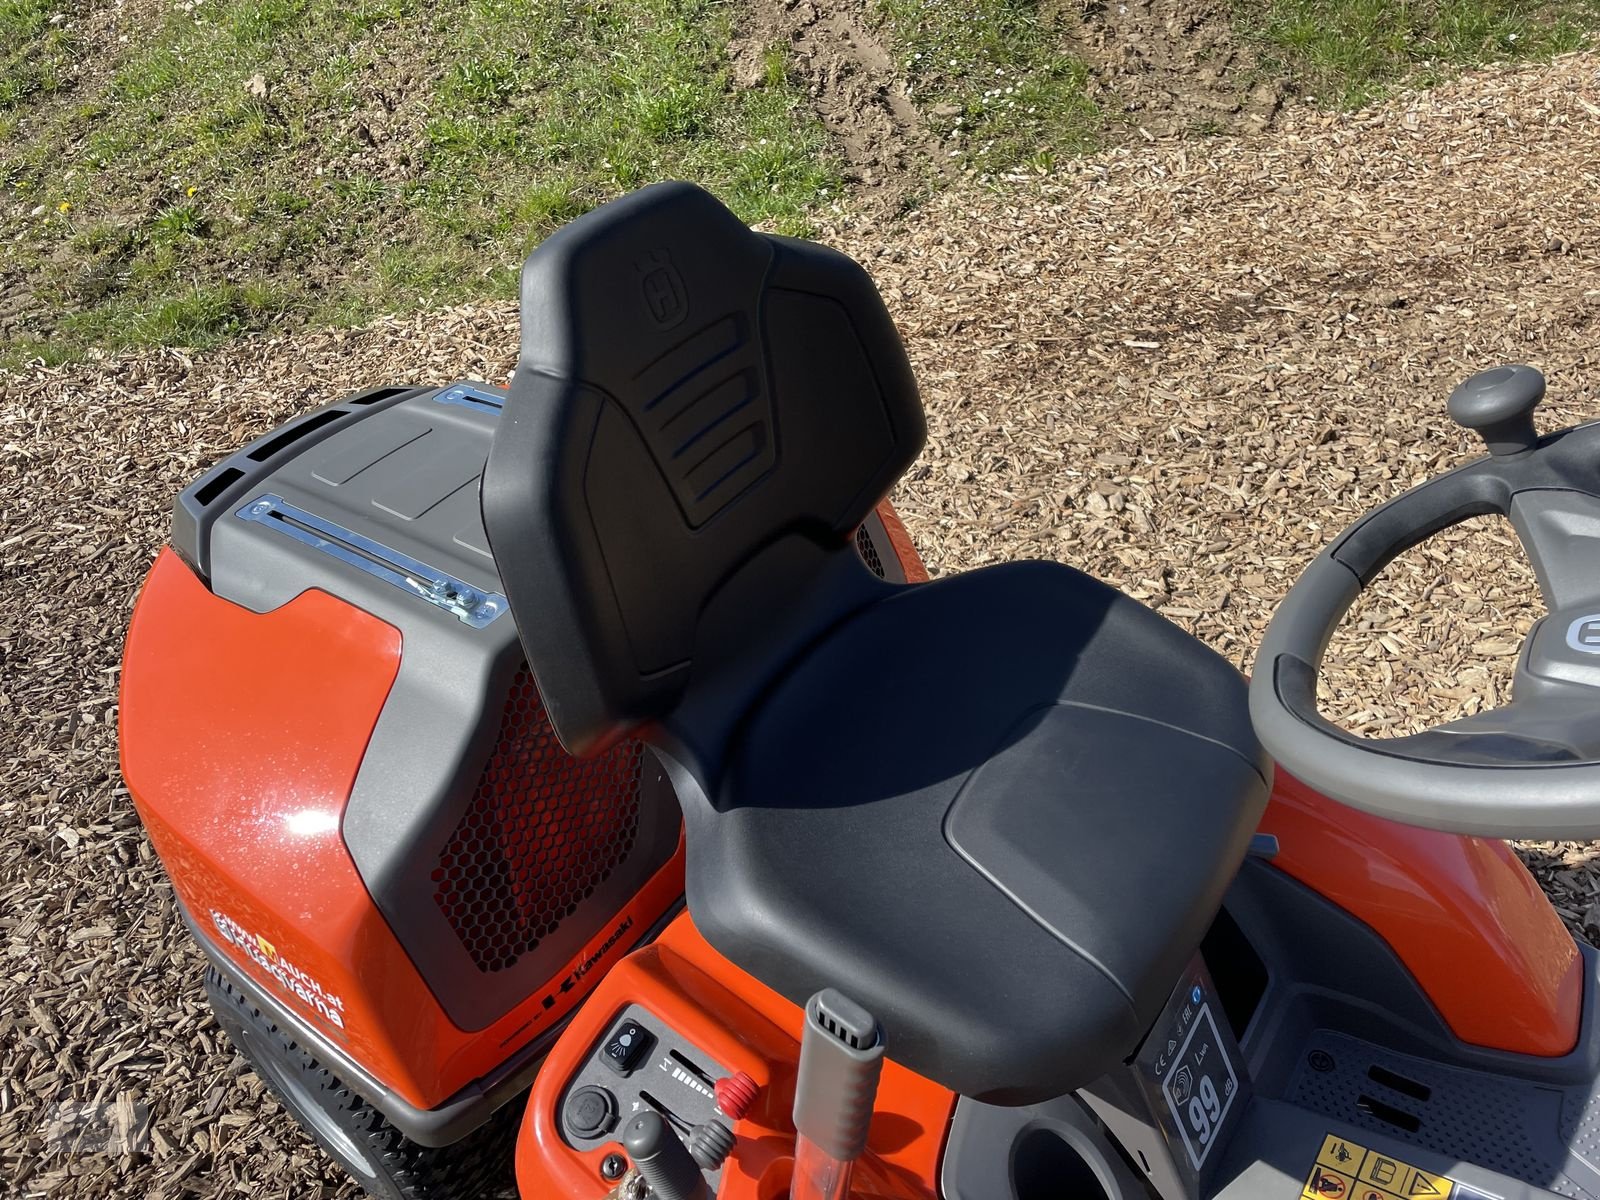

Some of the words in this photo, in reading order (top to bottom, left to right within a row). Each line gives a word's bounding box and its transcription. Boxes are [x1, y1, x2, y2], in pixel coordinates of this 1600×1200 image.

[231, 928, 345, 1029] Husqvarna
[573, 915, 634, 981] Kawasaki
[1188, 1074, 1221, 1145] 99
